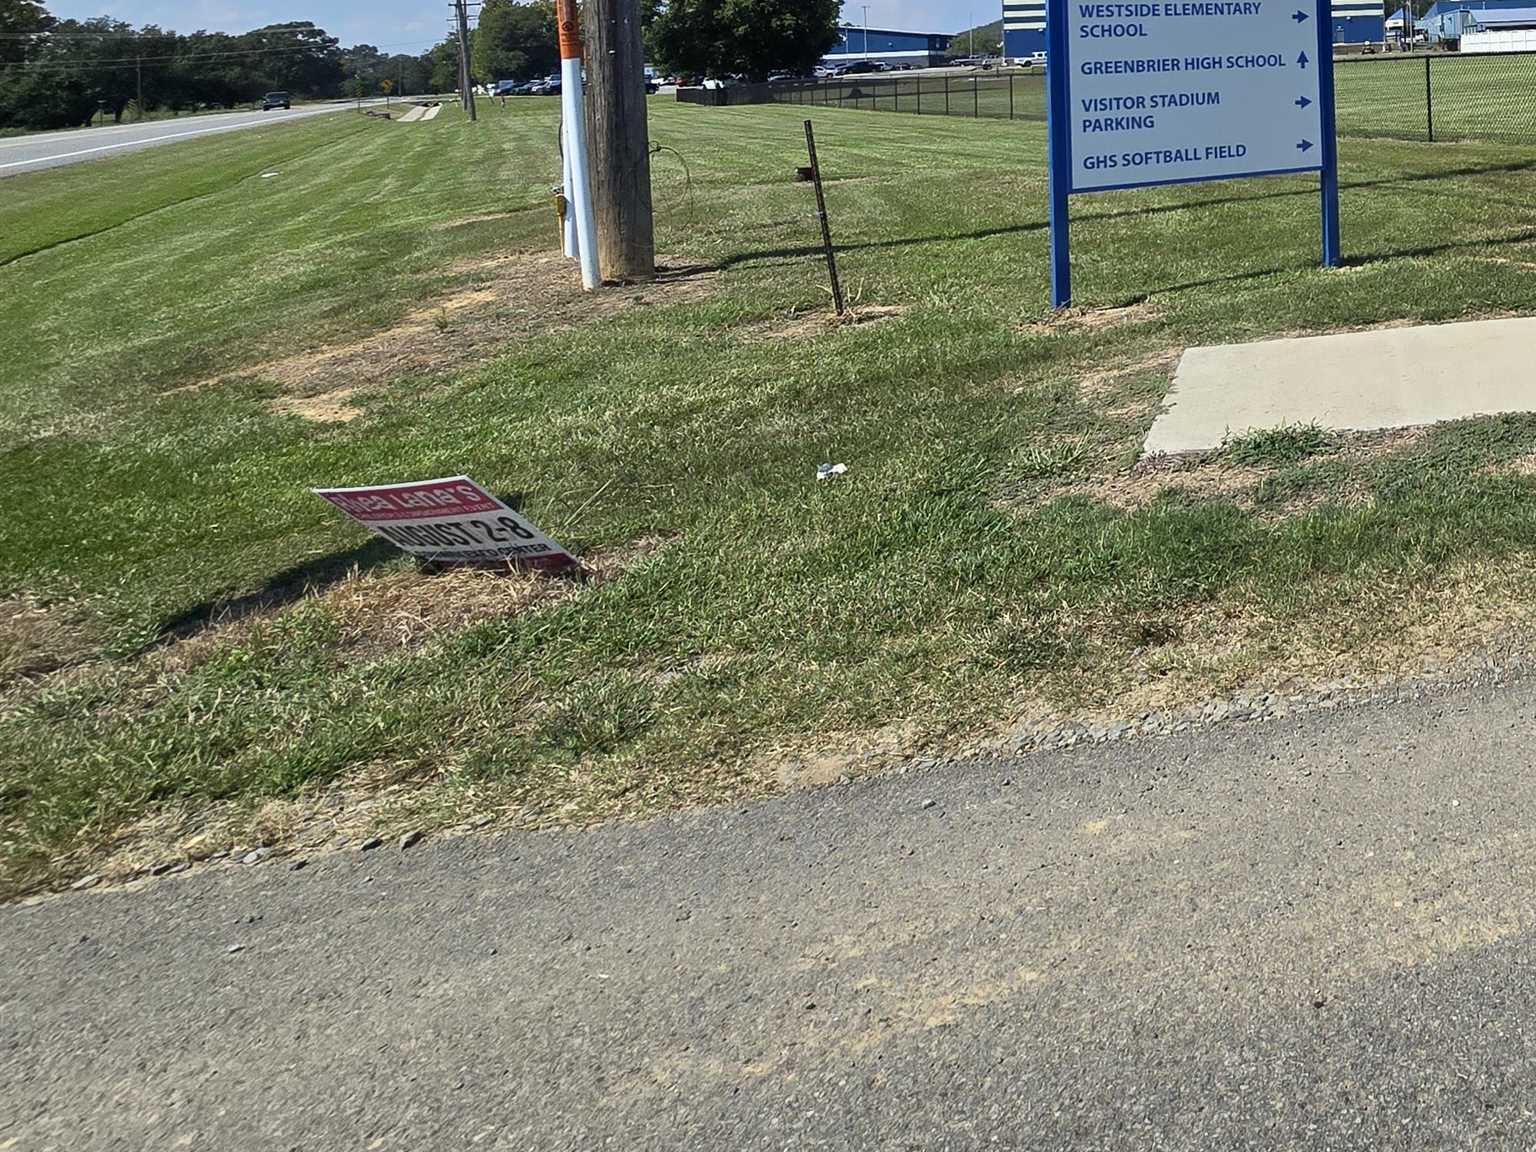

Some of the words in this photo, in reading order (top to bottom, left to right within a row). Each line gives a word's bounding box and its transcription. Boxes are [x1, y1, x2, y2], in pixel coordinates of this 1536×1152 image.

[1080, 4, 1161, 18] WESTSIDE
[1164, 2, 1262, 17] ELEMENTARY
[1080, 24, 1148, 38] SCHOOL
[1081, 59, 1181, 75] GREENBRIER
[1184, 56, 1223, 71] HIGH
[1226, 54, 1286, 69] SCHOOL
[1082, 96, 1146, 112] VISITOR
[1150, 92, 1220, 108] STADIUM
[1082, 116, 1155, 133] PARKING
[1083, 155, 1117, 170] GHS
[1122, 147, 1202, 168] SOFTBALL
[1205, 144, 1247, 160] FIELD
[391, 486, 482, 508] Lana's
[377, 522, 483, 548] AUGUST
[471, 517, 535, 542] 2-8
